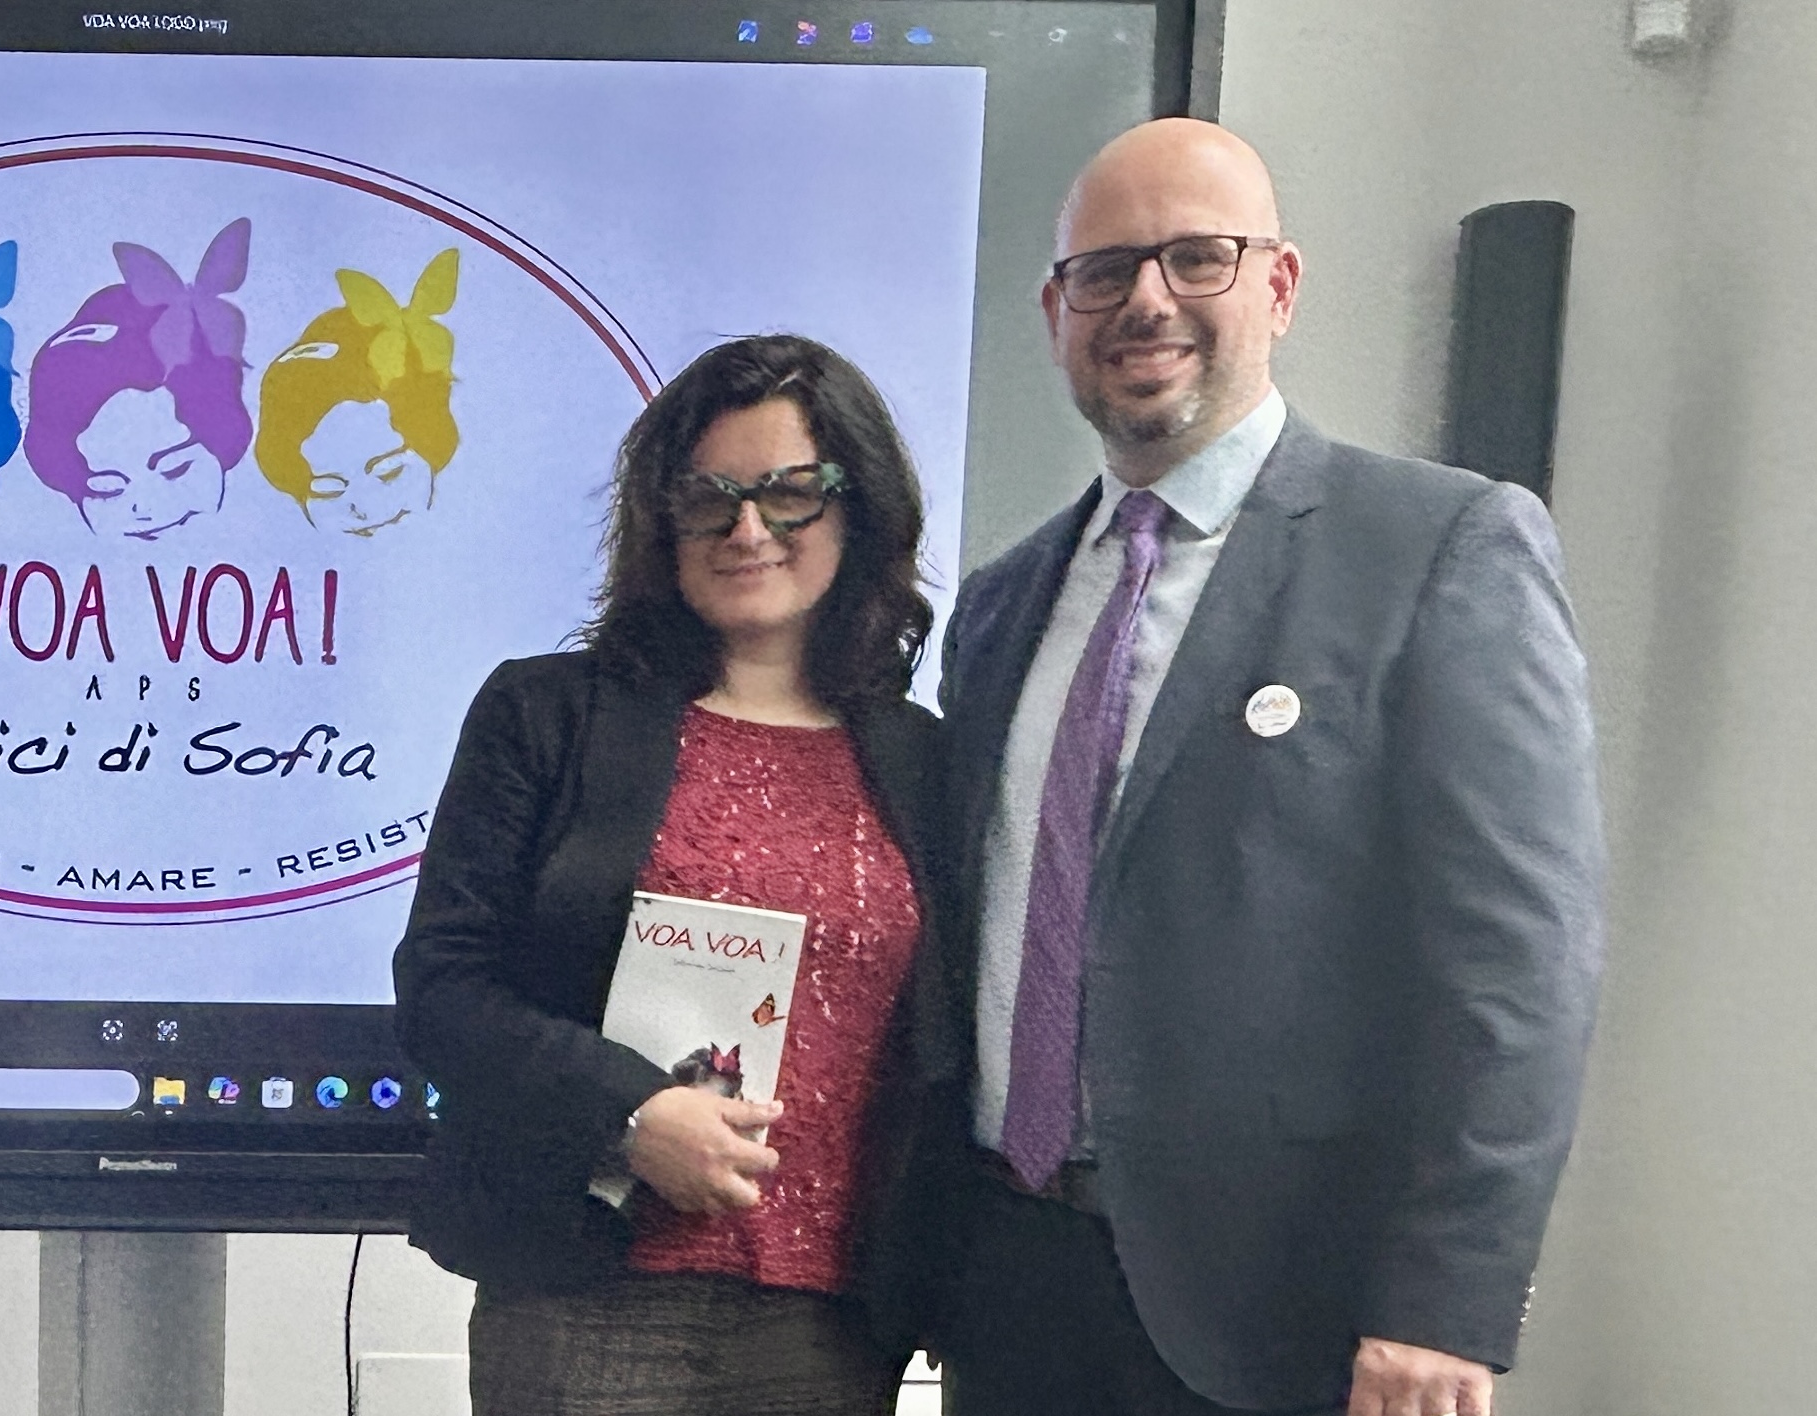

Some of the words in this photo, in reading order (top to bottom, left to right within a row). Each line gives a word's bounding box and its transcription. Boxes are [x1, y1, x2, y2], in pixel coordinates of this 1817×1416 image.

[145, 562, 339, 666] VOA!
[97, 721, 160, 773] di
[183, 721, 378, 782] Sofia
[56, 865, 217, 892] AMARE
[277, 809, 430, 879] RESIST
[635, 920, 695, 951] VOA
[706, 931, 766, 963] VOA
